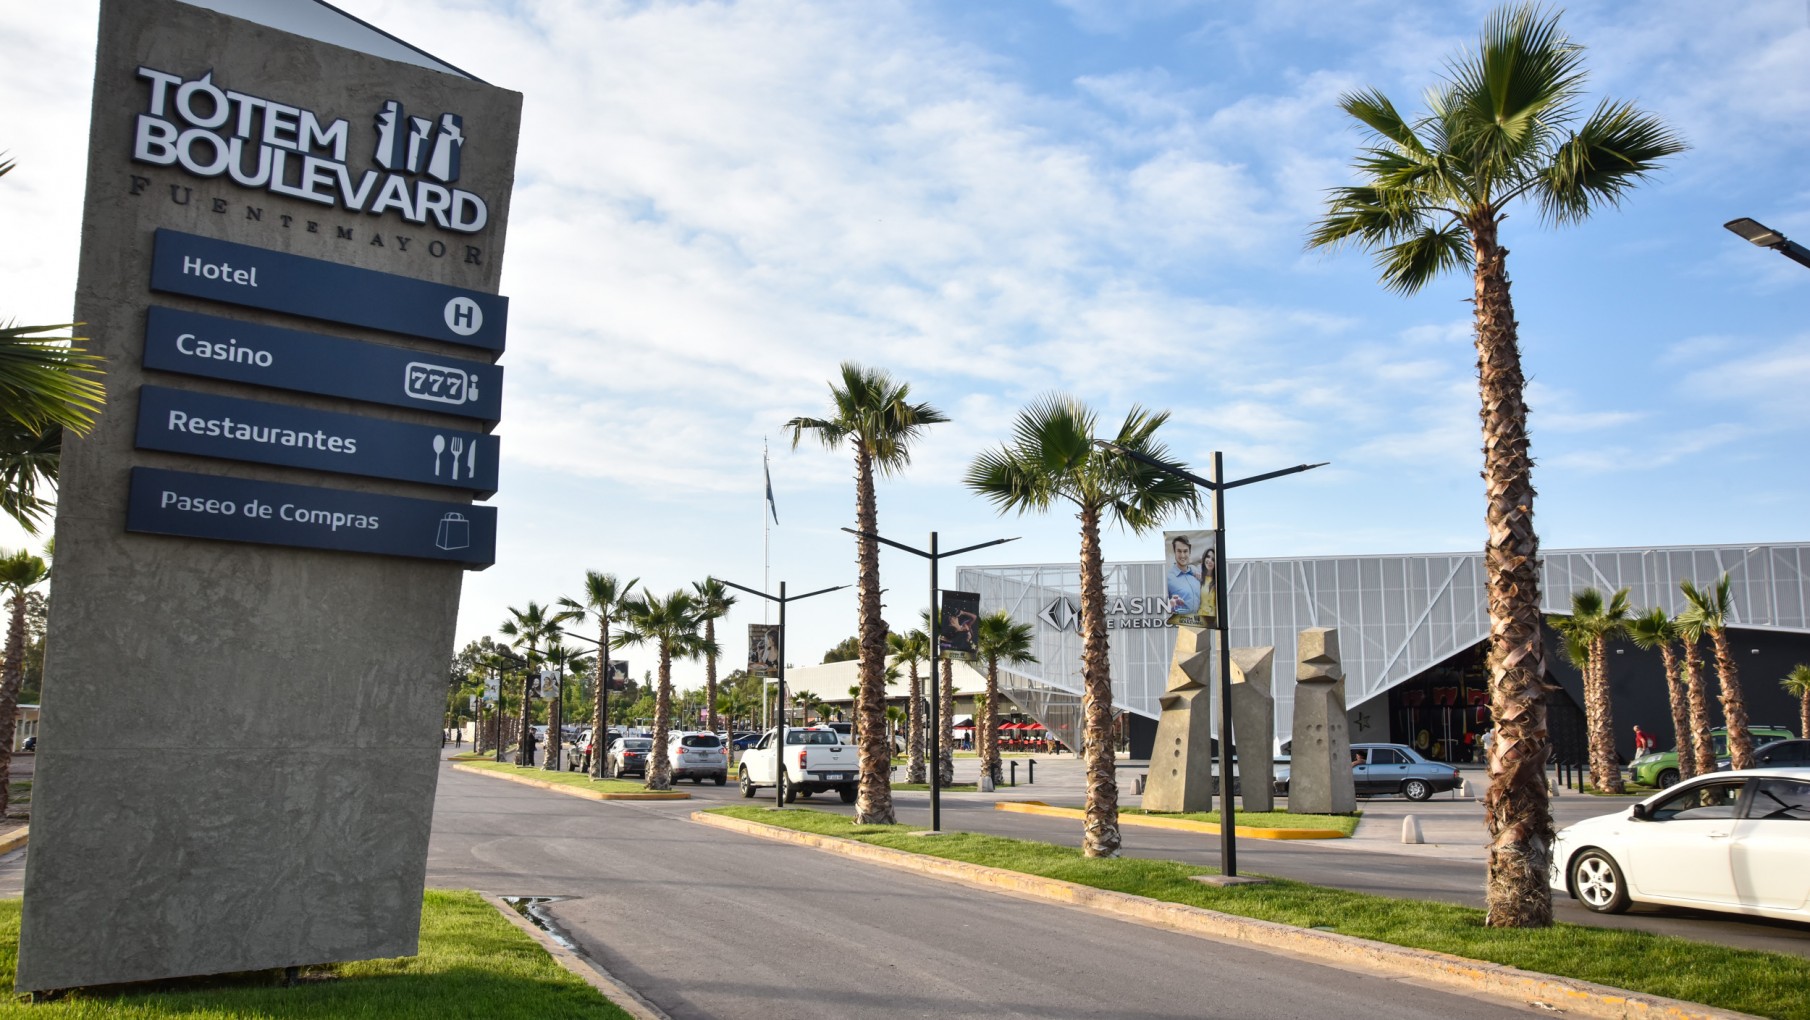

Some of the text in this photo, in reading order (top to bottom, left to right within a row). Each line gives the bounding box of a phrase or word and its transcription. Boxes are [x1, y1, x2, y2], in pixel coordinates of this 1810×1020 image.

[136, 65, 350, 162] TÓTEM
[132, 112, 489, 235] BOULEVARD
[129, 175, 482, 266] FUENTEMAYOR
[182, 256, 258, 287] Hotel
[453, 304, 474, 329] H
[176, 333, 273, 367] Casino
[410, 370, 462, 395] 777
[168, 410, 357, 454] Restaurantes
[161, 490, 379, 531] Paseo de Compras
[1104, 597, 1172, 615] ASIN
